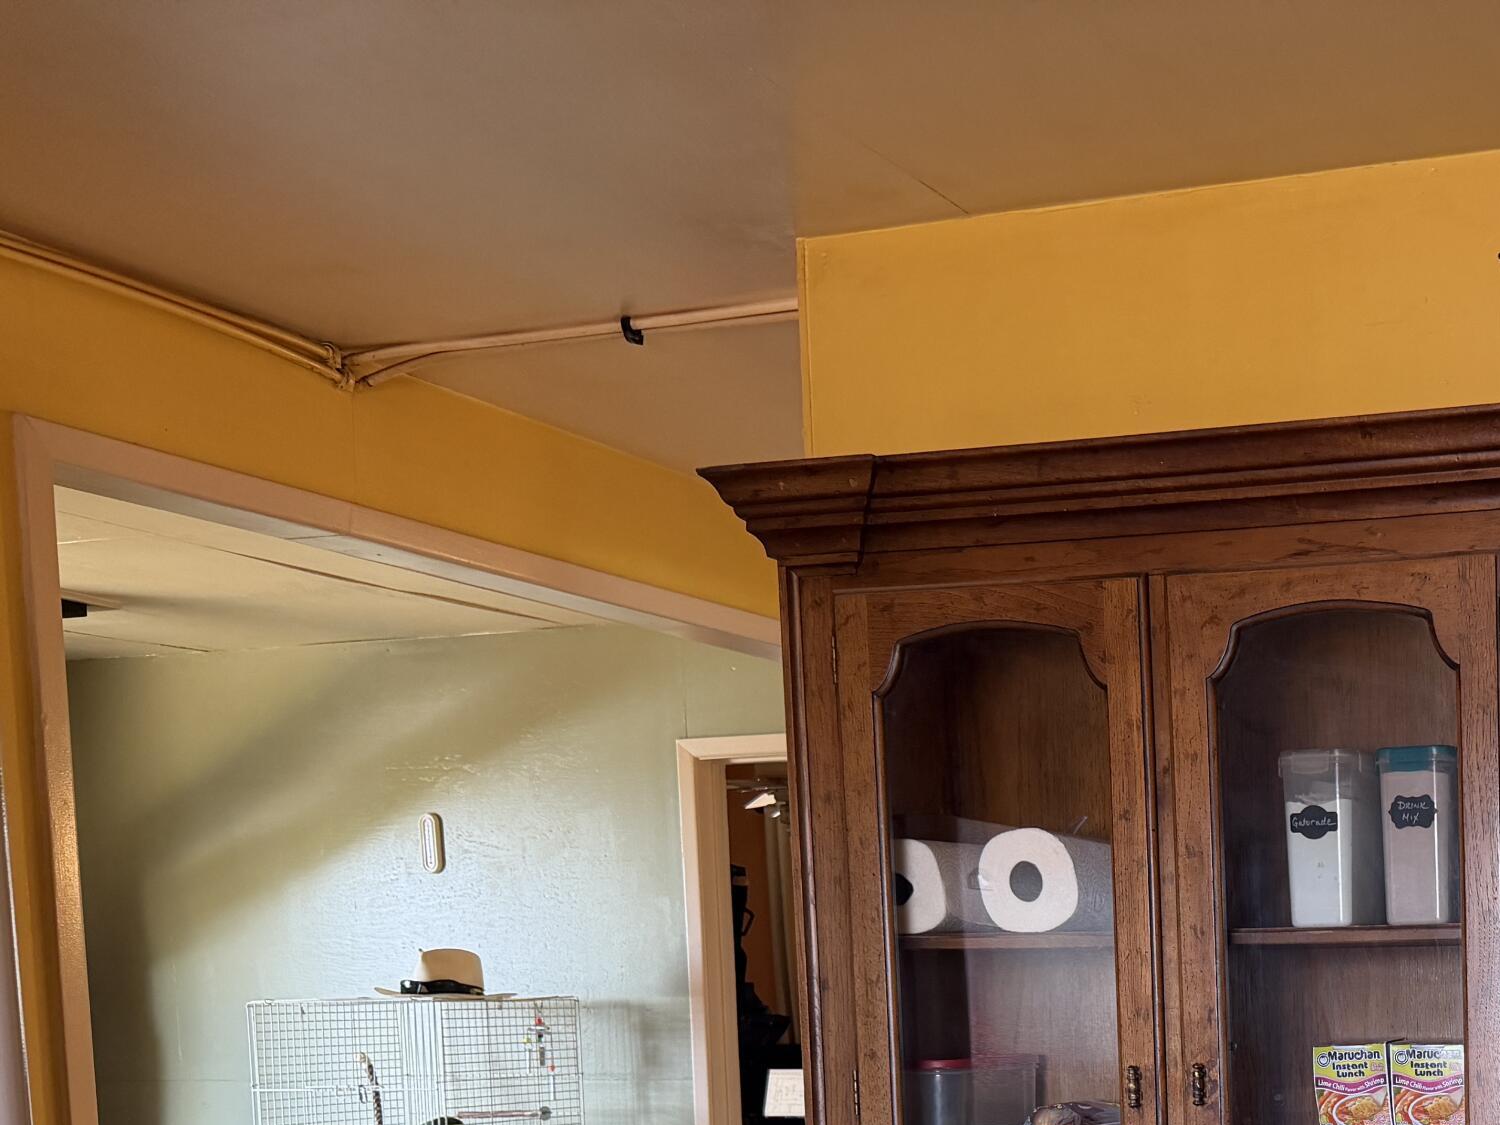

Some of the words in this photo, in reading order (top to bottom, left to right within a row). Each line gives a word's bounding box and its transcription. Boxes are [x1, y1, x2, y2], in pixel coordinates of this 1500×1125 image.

[1291, 816, 1337, 829] Gatorade
[1327, 1049, 1381, 1060] Maruchan
[1332, 1061, 1368, 1070] Instant
[1410, 1060, 1447, 1069] Instant
[1337, 1069, 1365, 1077] Lunch
[1414, 1069, 1443, 1077] Lunch
